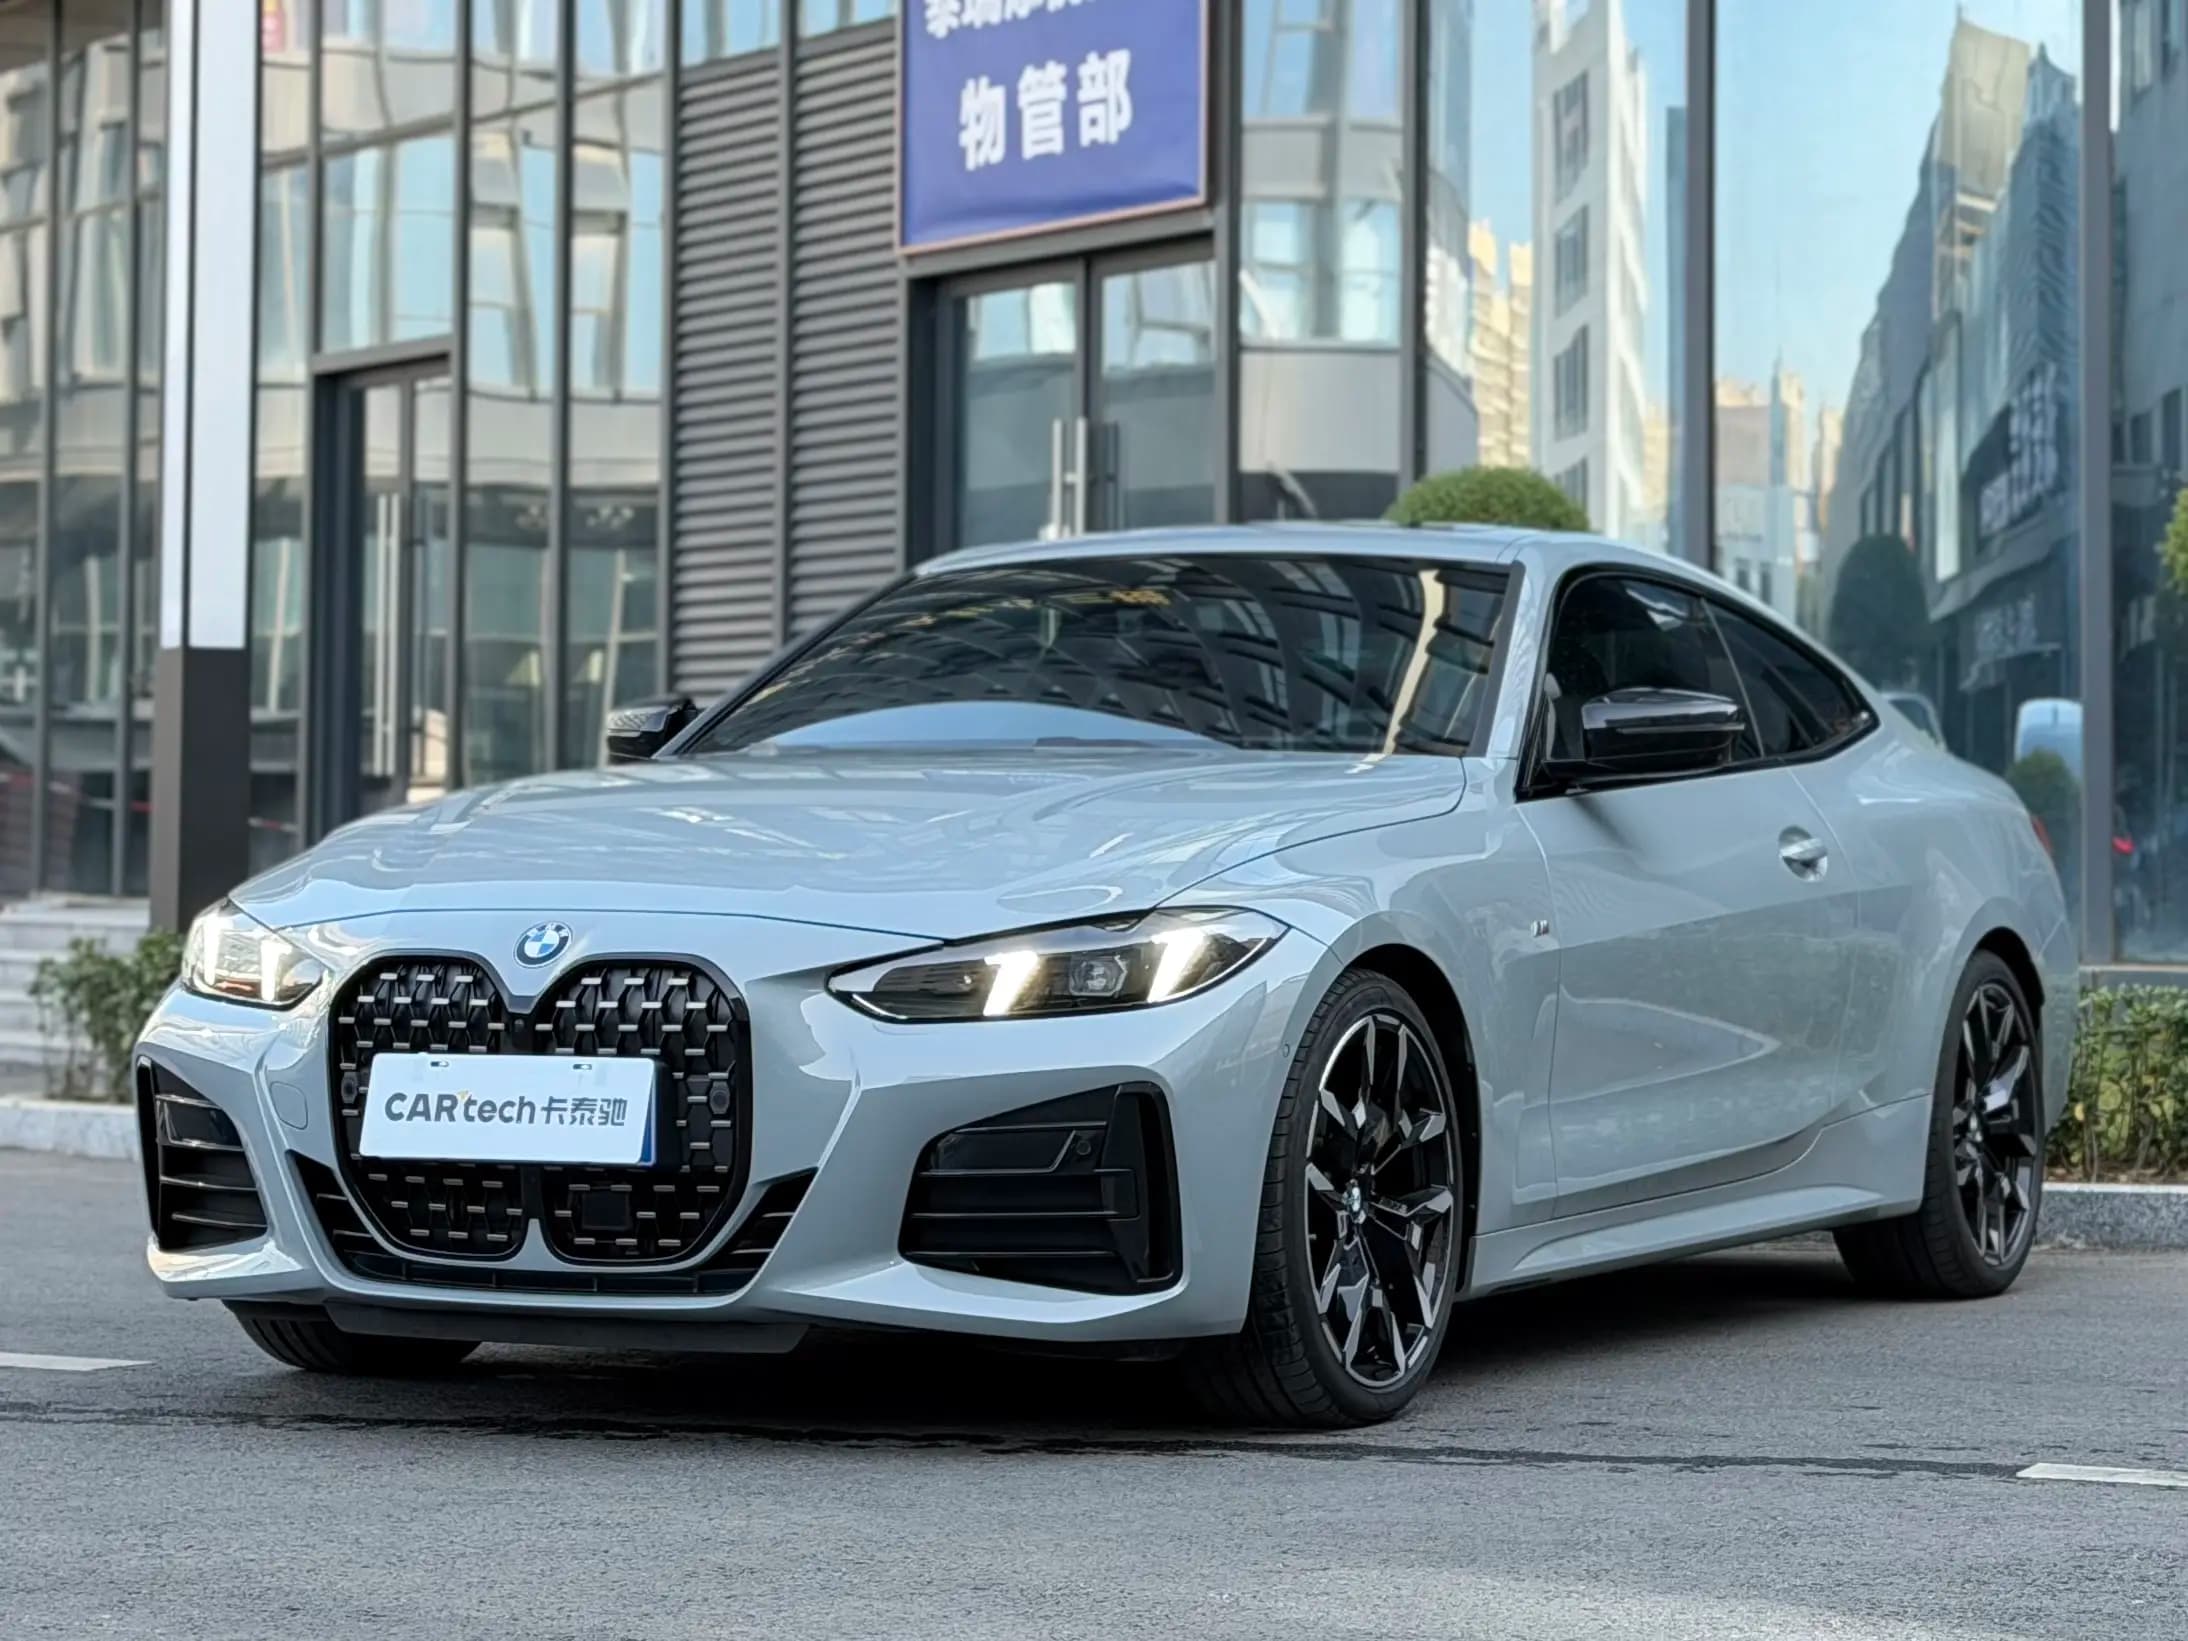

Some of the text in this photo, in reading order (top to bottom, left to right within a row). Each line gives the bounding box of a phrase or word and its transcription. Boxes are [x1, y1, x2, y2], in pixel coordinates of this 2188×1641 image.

[958, 48, 1132, 171] 物管部
[384, 1091, 628, 1127] CARtech 卡泰驰
